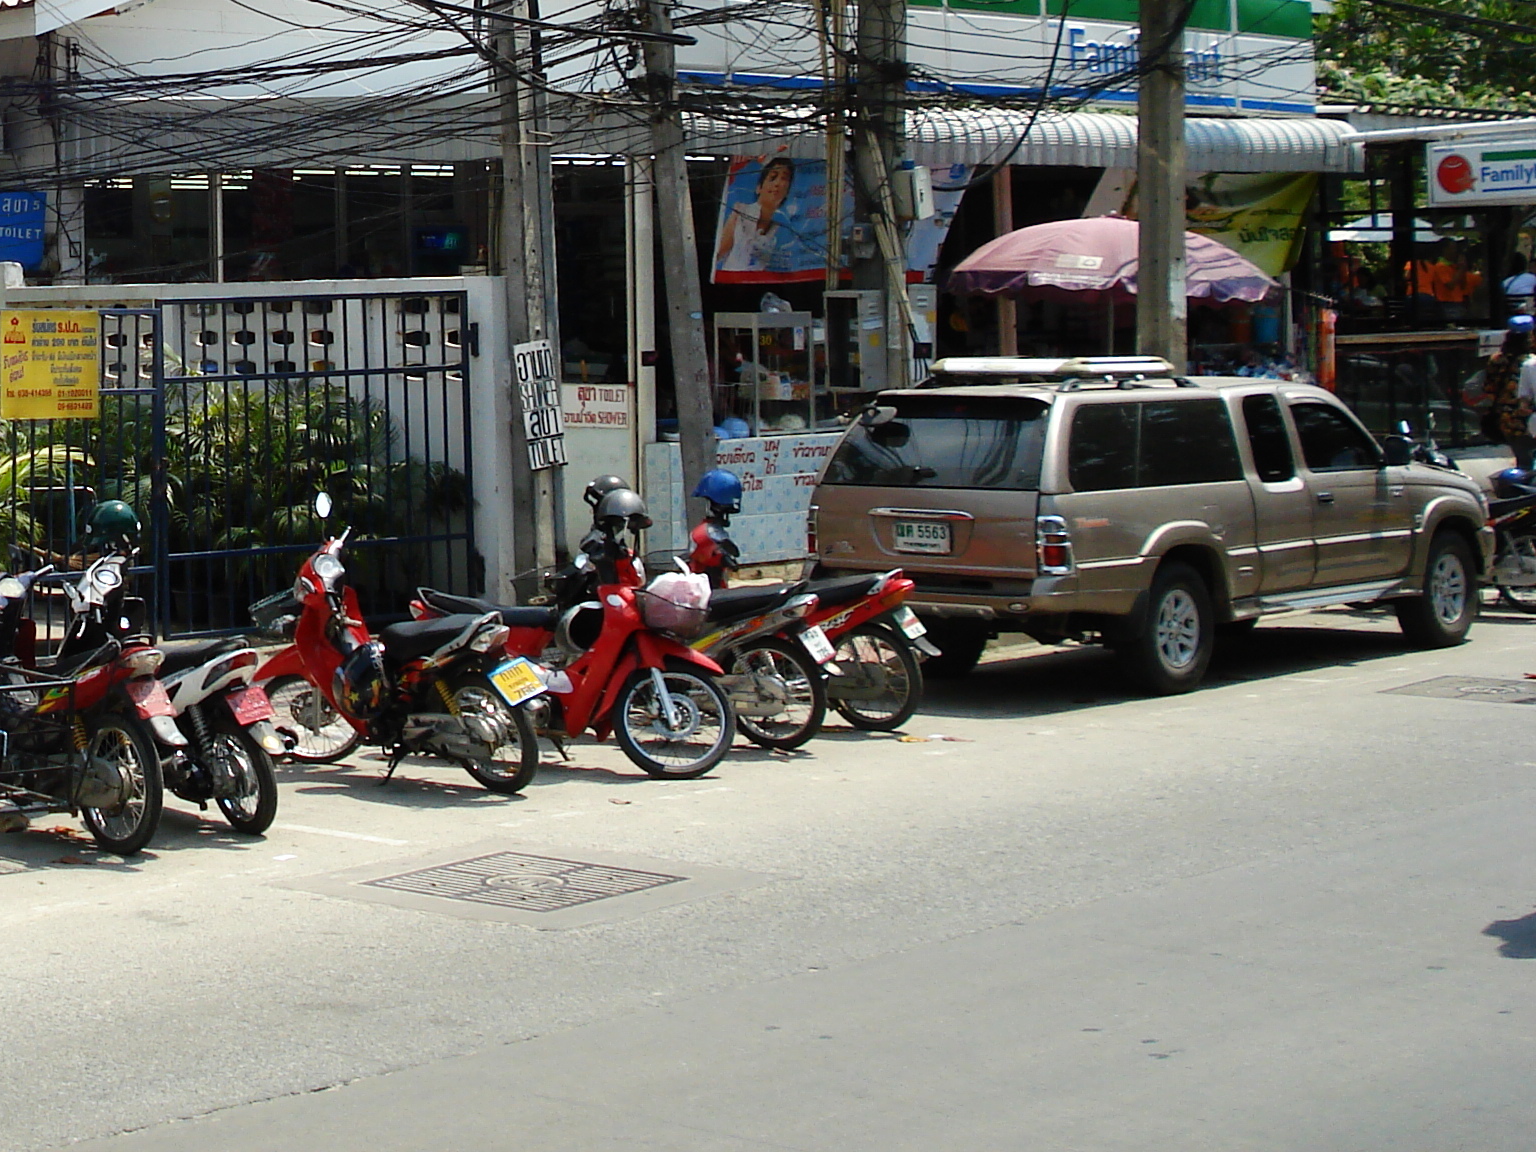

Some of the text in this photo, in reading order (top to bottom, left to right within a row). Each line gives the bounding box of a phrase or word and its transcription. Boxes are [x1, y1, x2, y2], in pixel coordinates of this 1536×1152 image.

[1067, 25, 1223, 83] Famiart
[1480, 162, 1536, 184] Family
[917, 524, 946, 540] 5563
